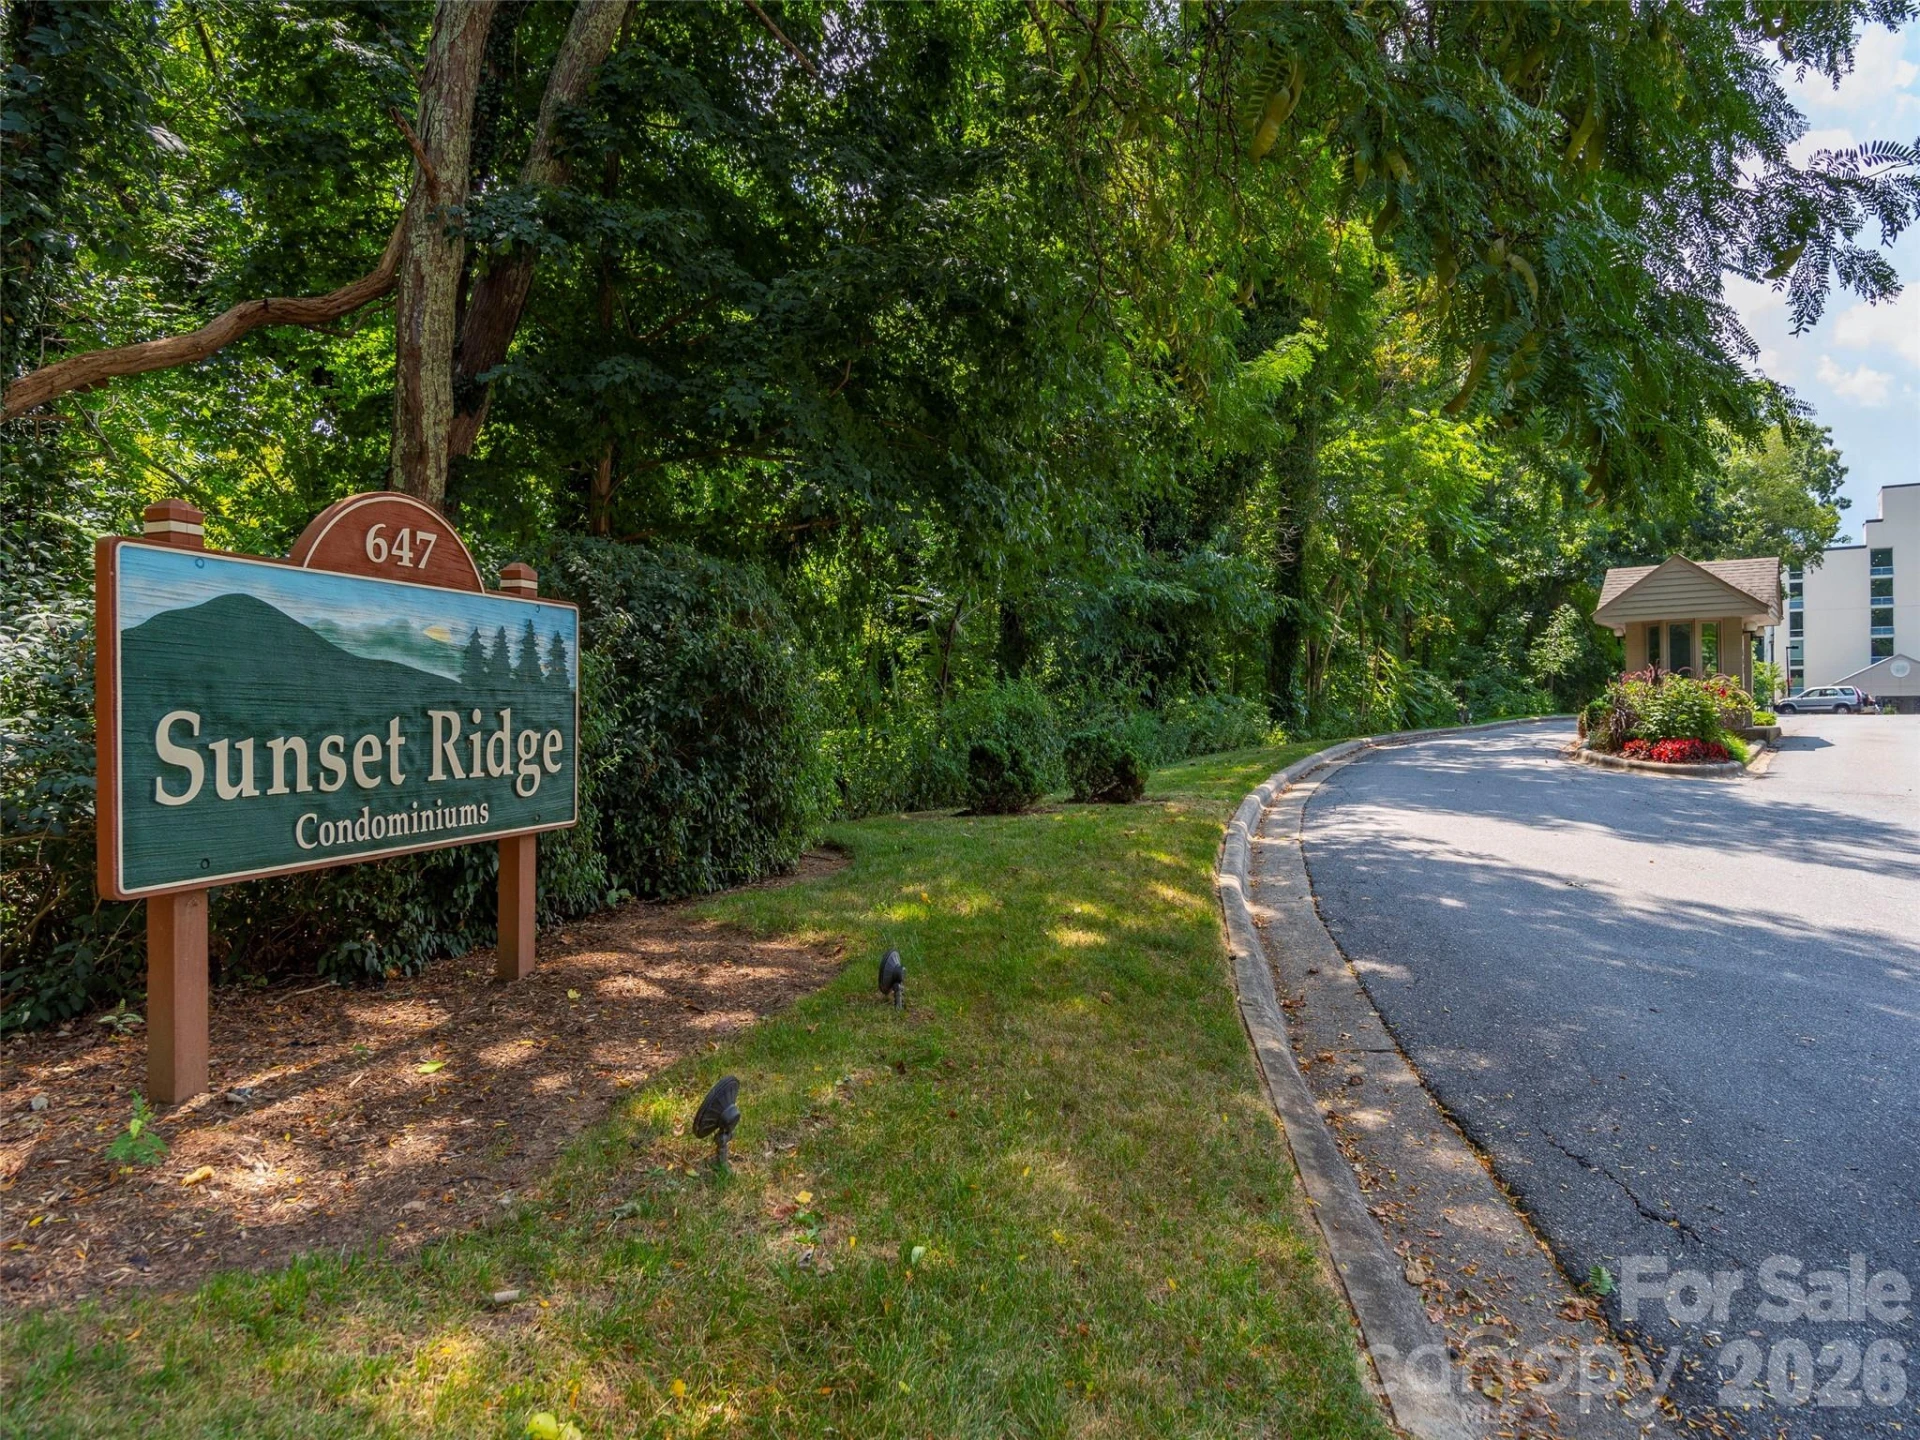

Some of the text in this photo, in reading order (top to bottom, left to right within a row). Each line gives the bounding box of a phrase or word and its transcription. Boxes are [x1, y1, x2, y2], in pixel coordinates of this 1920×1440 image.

[365, 523, 438, 570] 647
[154, 707, 563, 807] Sunset Ridge
[295, 801, 489, 850] Condominiums
